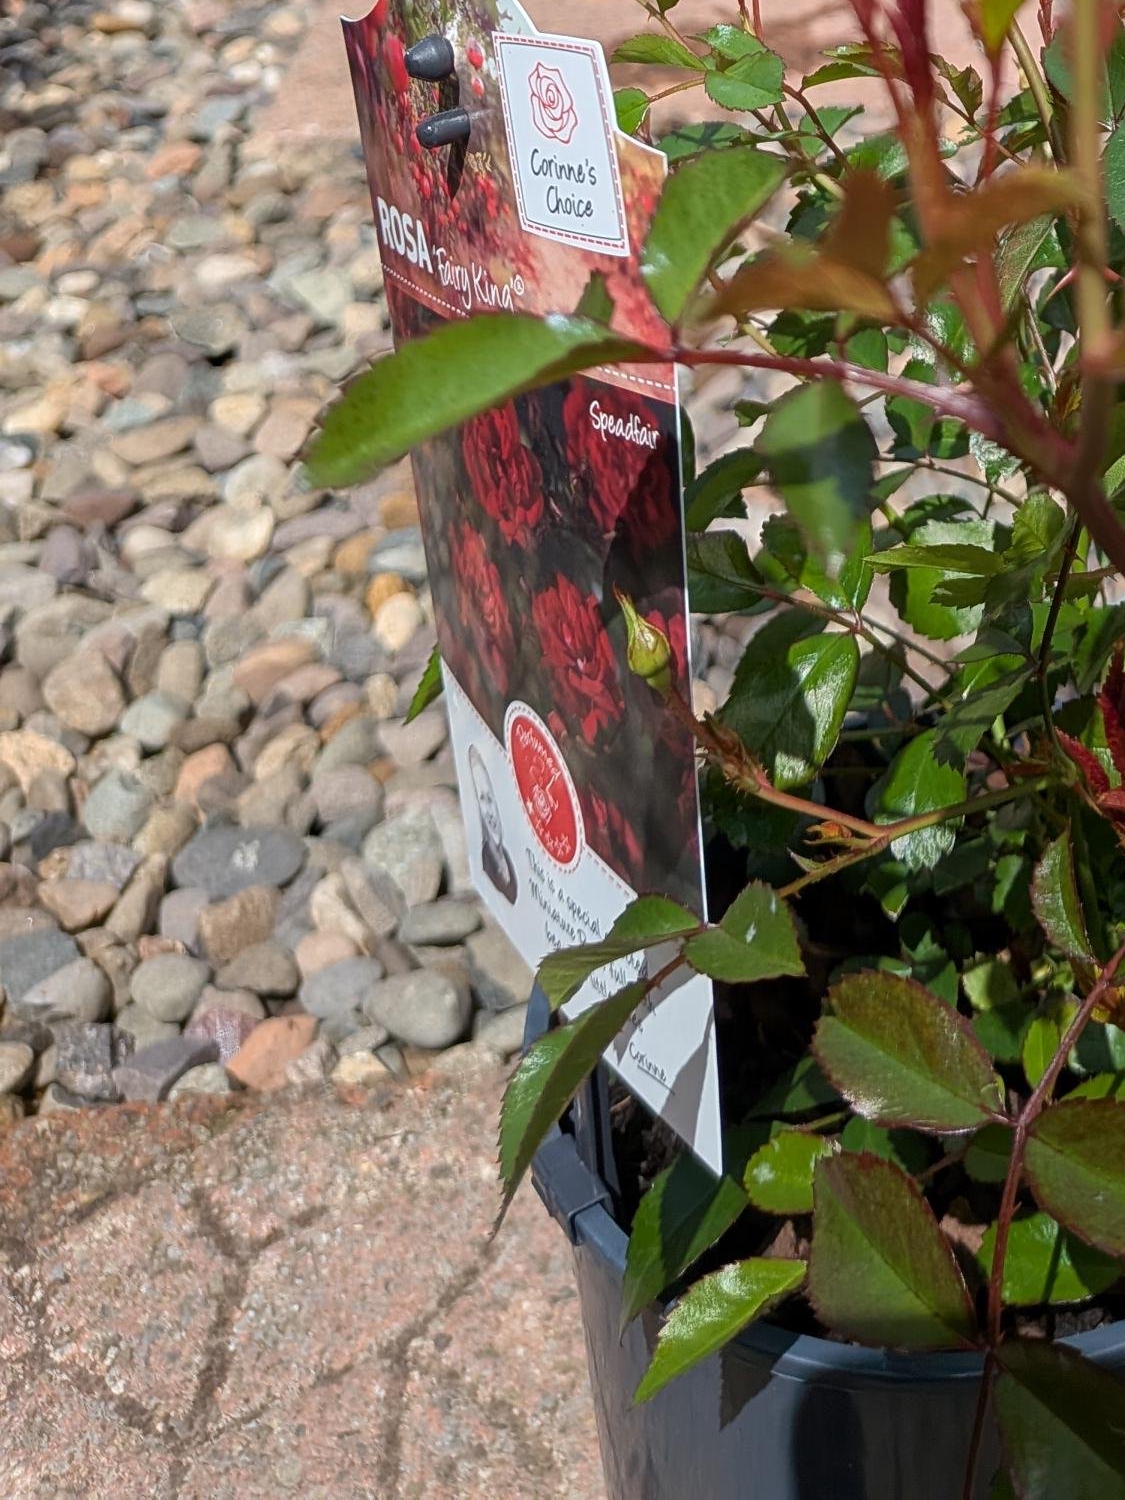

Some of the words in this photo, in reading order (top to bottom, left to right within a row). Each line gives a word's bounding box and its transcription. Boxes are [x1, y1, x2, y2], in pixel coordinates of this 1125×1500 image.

[530, 148, 597, 186] Corinne's
[546, 185, 594, 218] Choice
[377, 196, 434, 274] ROSA
[589, 400, 661, 450] Speadfair
[566, 895, 601, 937] special
